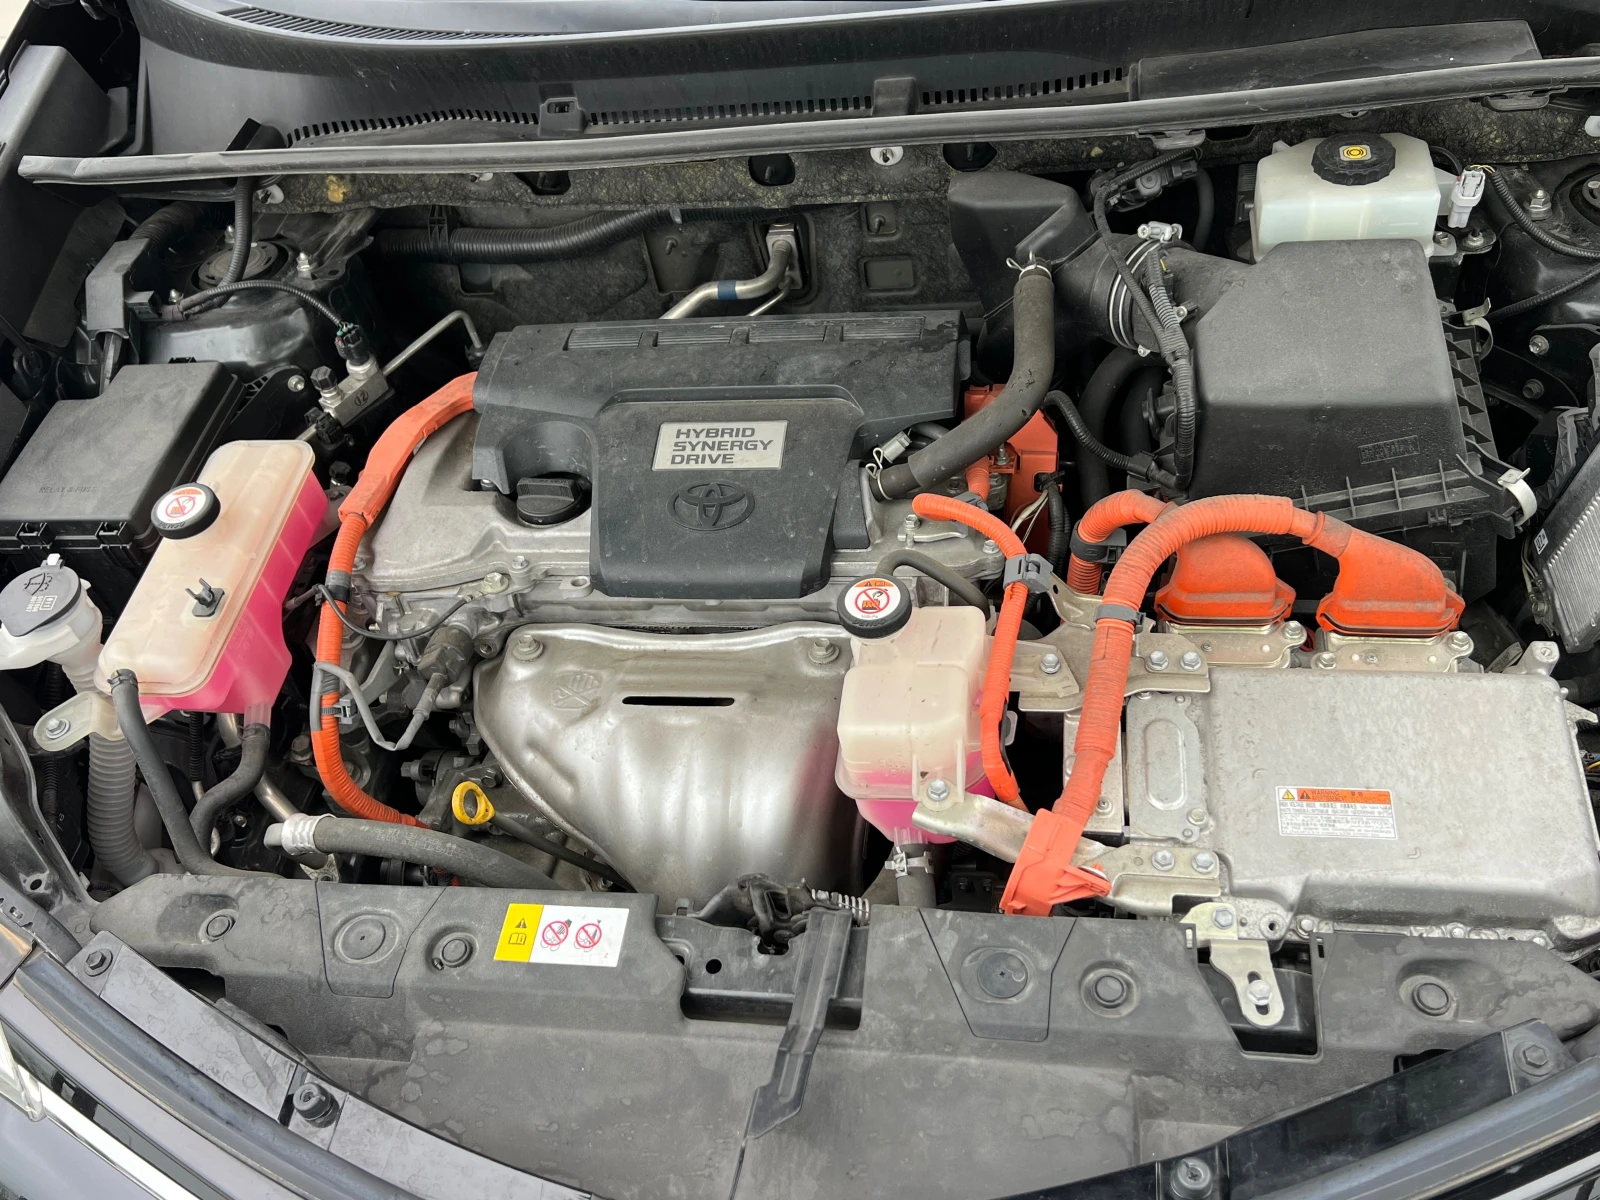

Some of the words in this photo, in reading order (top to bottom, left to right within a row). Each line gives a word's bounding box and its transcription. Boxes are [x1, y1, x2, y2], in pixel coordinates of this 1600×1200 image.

[355, 390, 368, 405] 12
[675, 427, 756, 439] HYBRID
[672, 439, 774, 452] SYNERGY
[670, 453, 735, 465] DRIVE
[38, 486, 66, 494] RELAY
[157, 521, 186, 529] DENSO
[851, 619, 887, 627] DENSO
